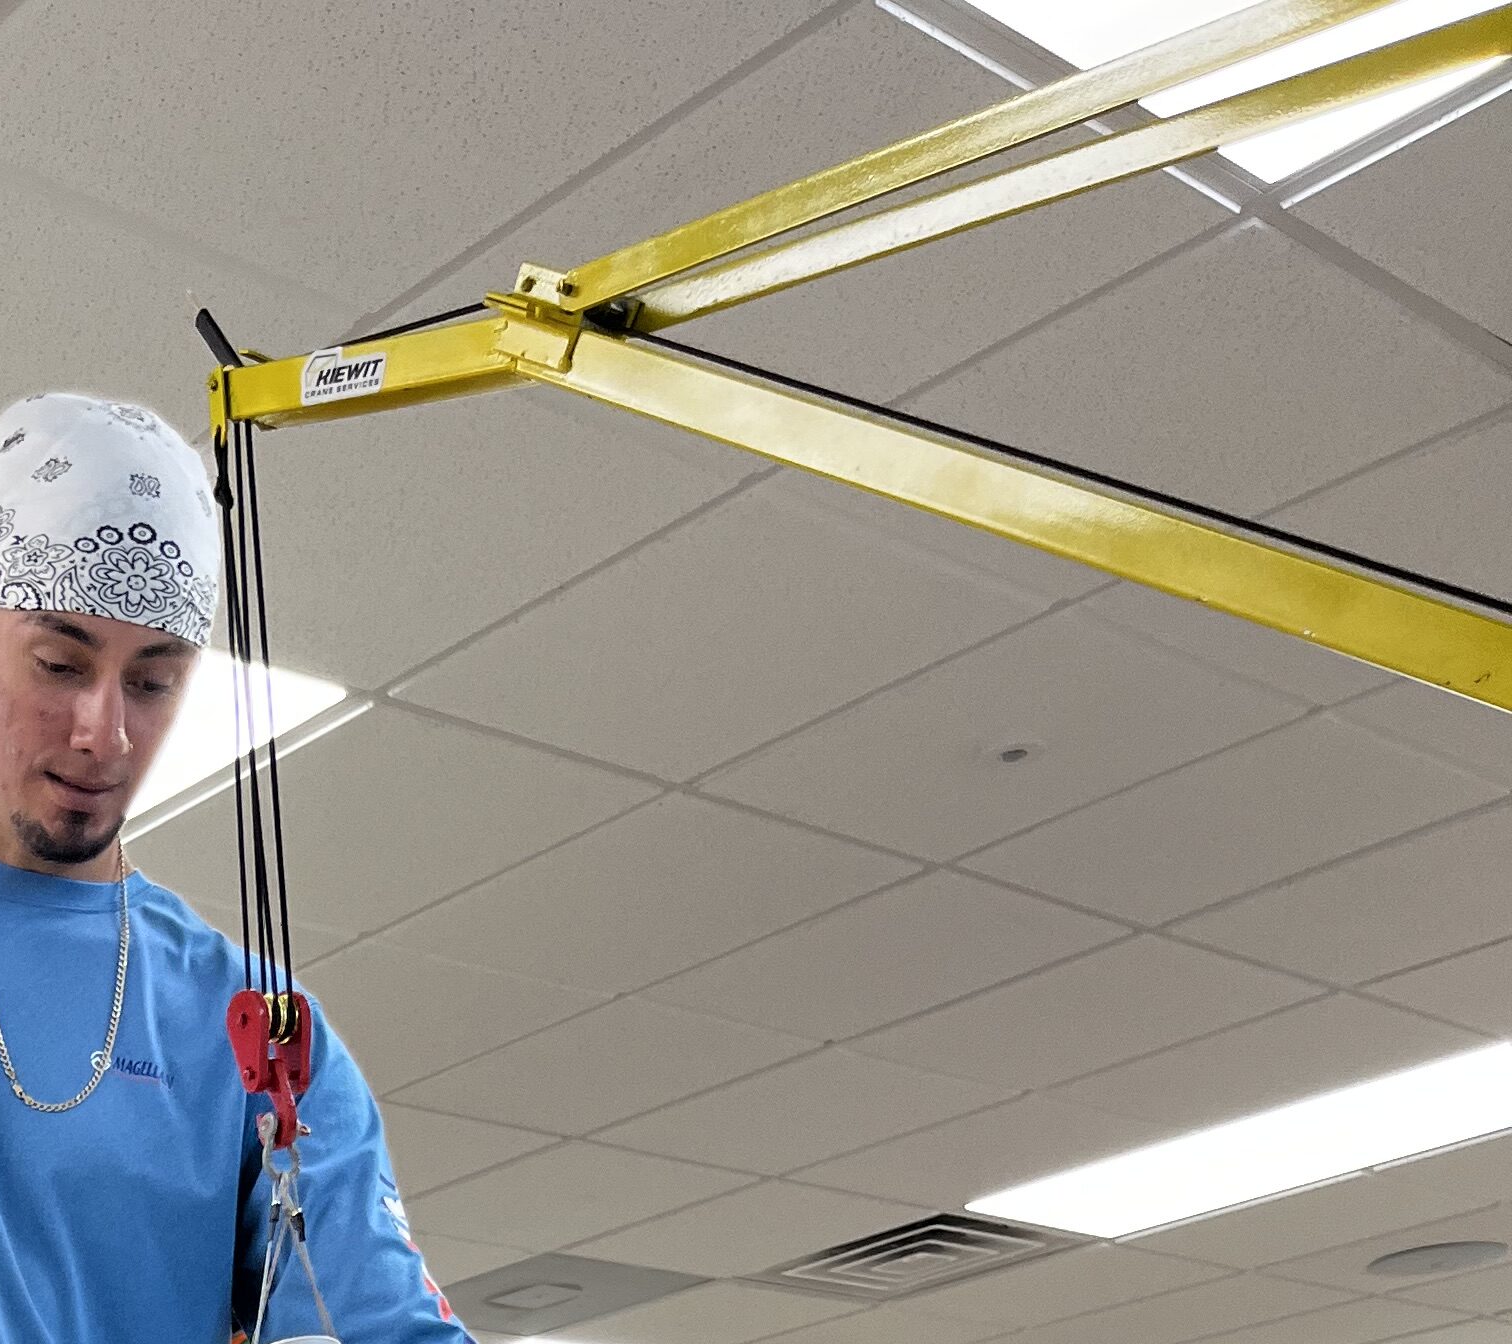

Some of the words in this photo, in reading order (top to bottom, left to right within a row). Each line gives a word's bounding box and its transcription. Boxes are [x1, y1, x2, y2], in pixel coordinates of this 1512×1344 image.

[316, 359, 383, 387] KIEWIT
[304, 386, 334, 399] CRANE
[337, 379, 379, 392] SERVICES
